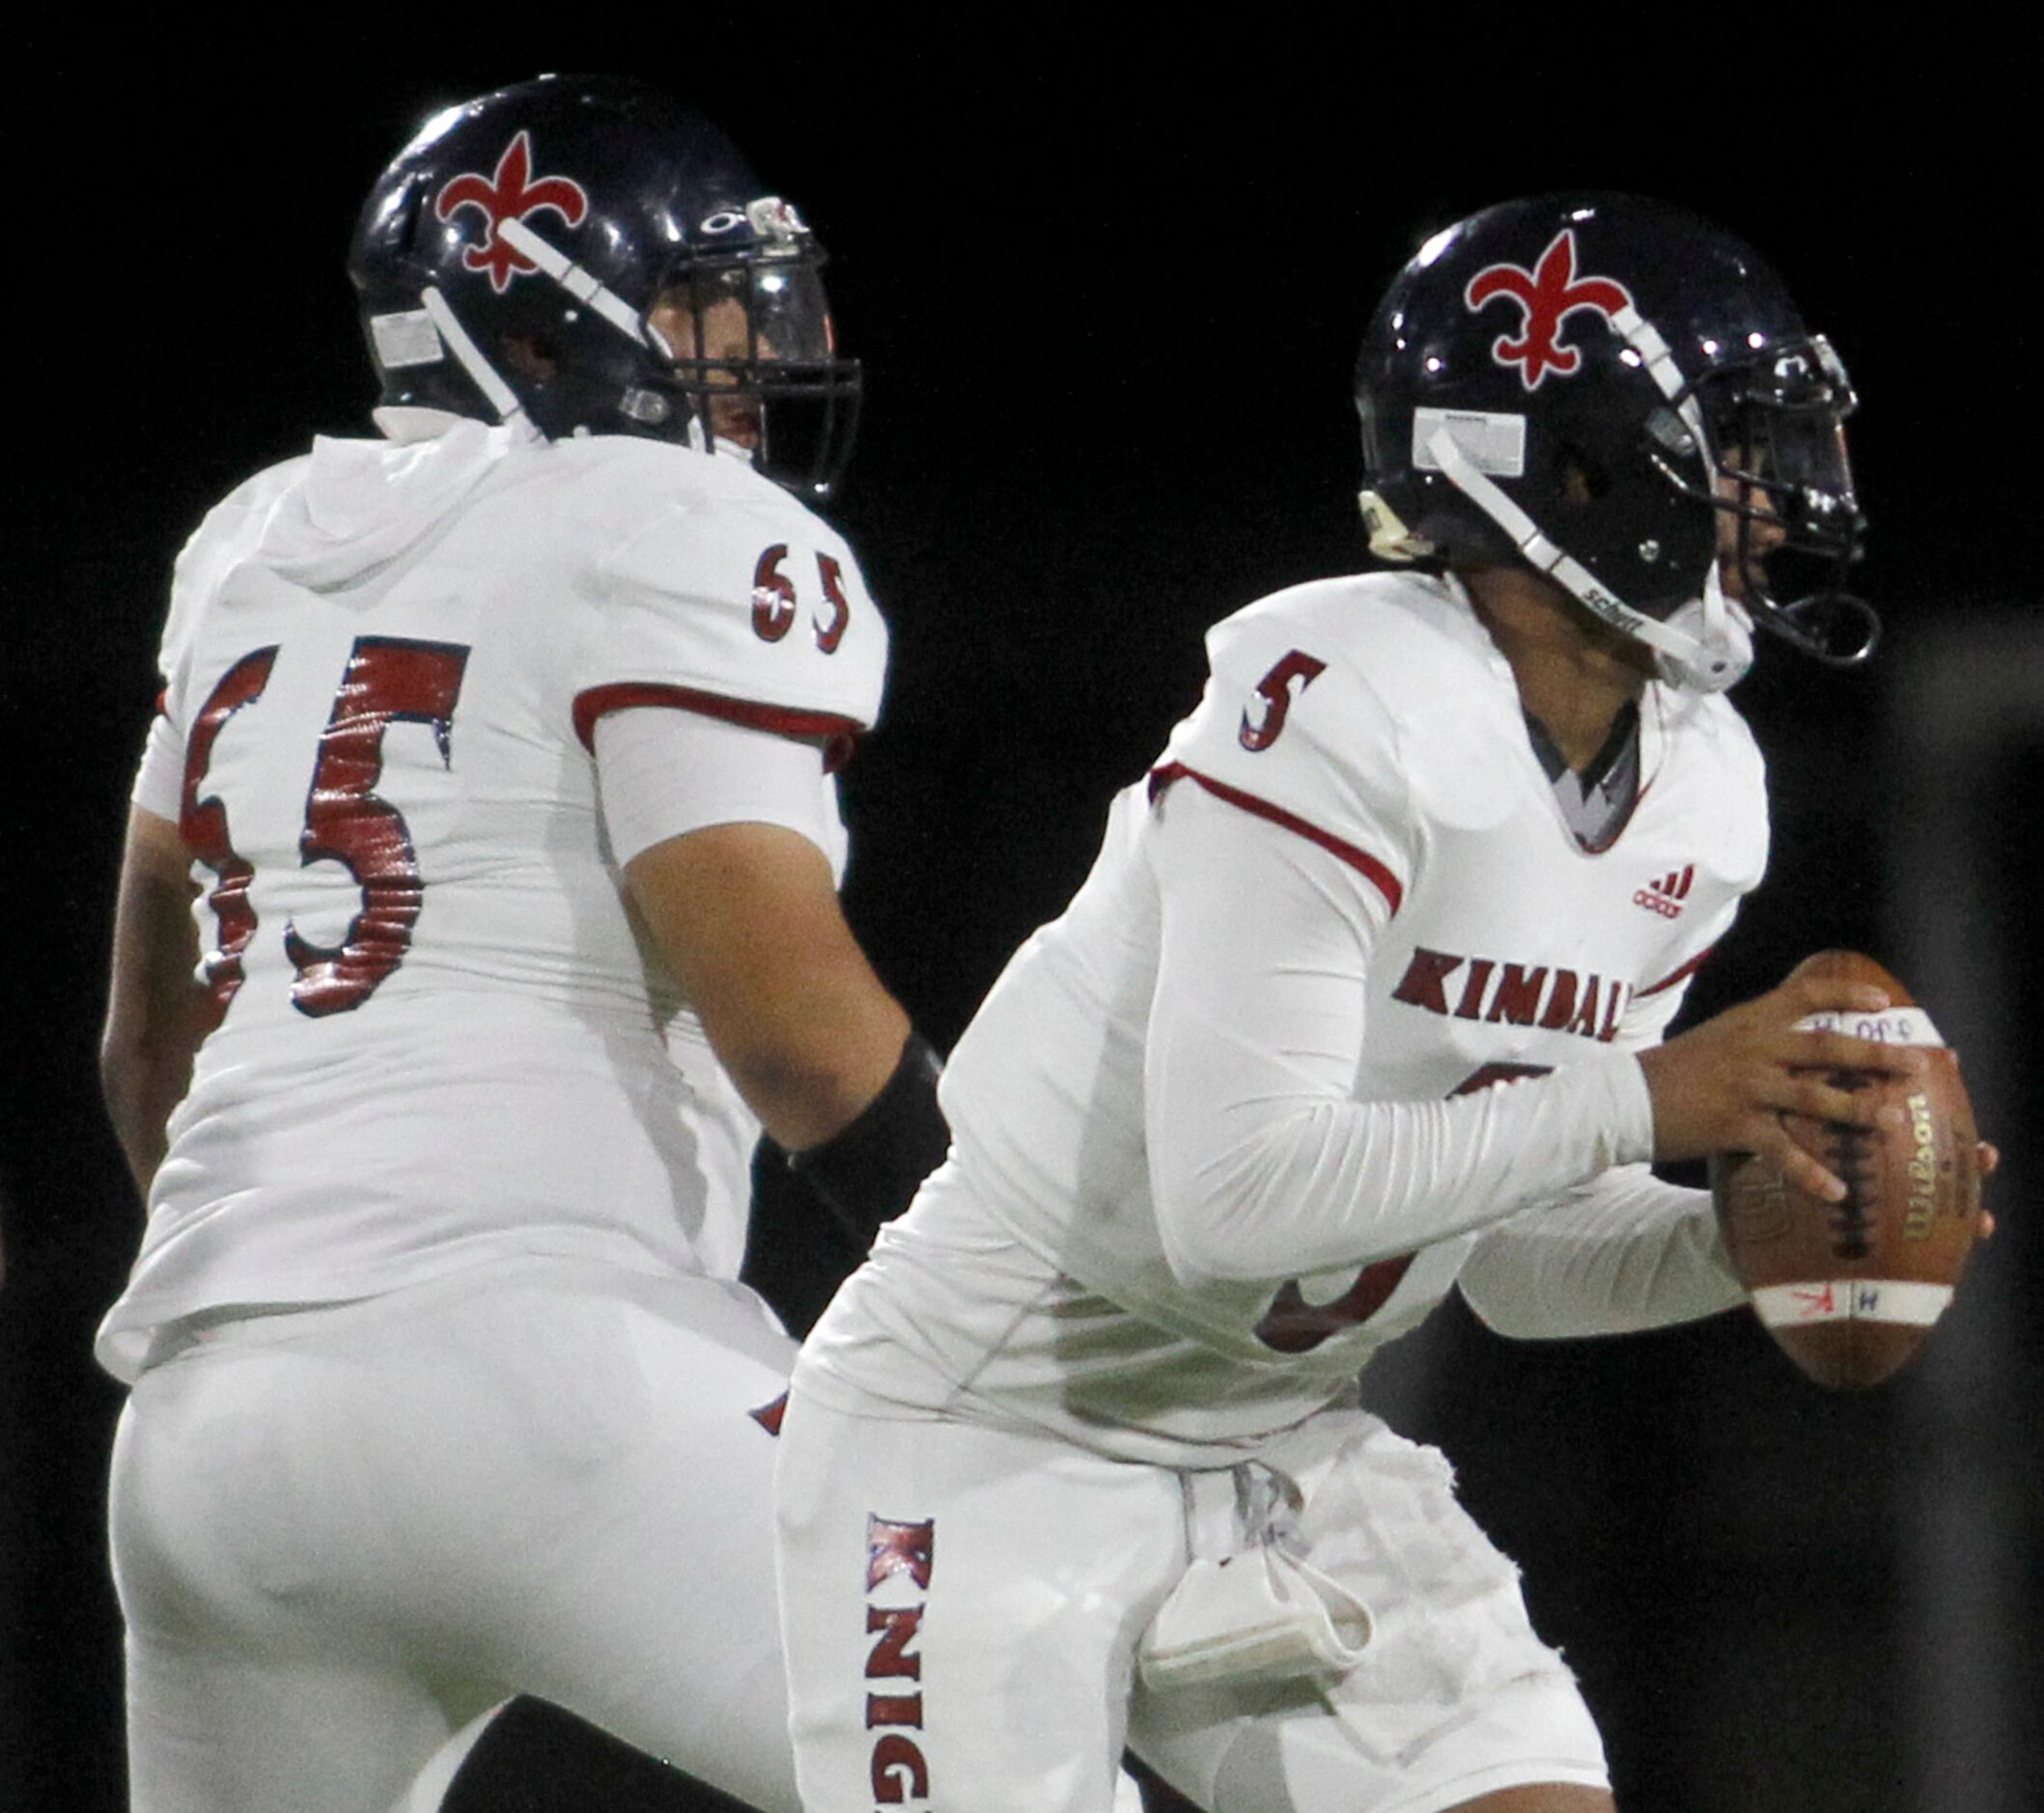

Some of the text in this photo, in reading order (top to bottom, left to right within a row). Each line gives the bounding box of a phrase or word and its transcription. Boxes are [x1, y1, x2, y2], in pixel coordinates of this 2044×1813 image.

[751, 544, 851, 655] 65
[1239, 649, 1328, 752] 5
[1390, 946, 1634, 1043] KIMBAL
[1903, 1093, 1937, 1241] Wilson
[864, 1512, 935, 1812] KNIG
